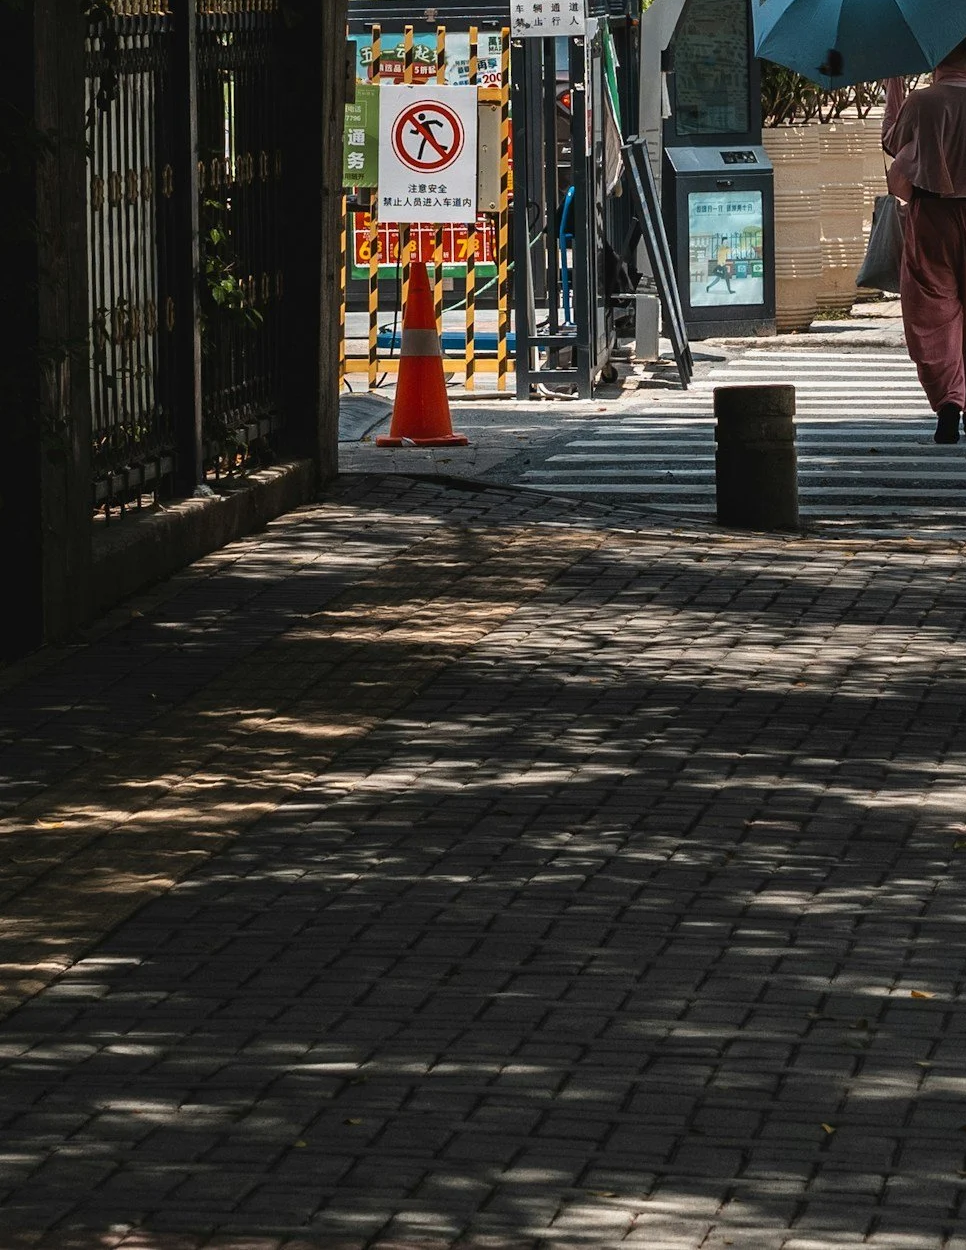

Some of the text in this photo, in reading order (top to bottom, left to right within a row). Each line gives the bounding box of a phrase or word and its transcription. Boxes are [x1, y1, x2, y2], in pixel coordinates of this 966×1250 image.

[515, 2, 579, 13] 车辆通道
[514, 15, 579, 28] 禁止行人
[408, 184, 448, 194] 注意安全
[383, 197, 472, 207] 禁止人员进入车道内
